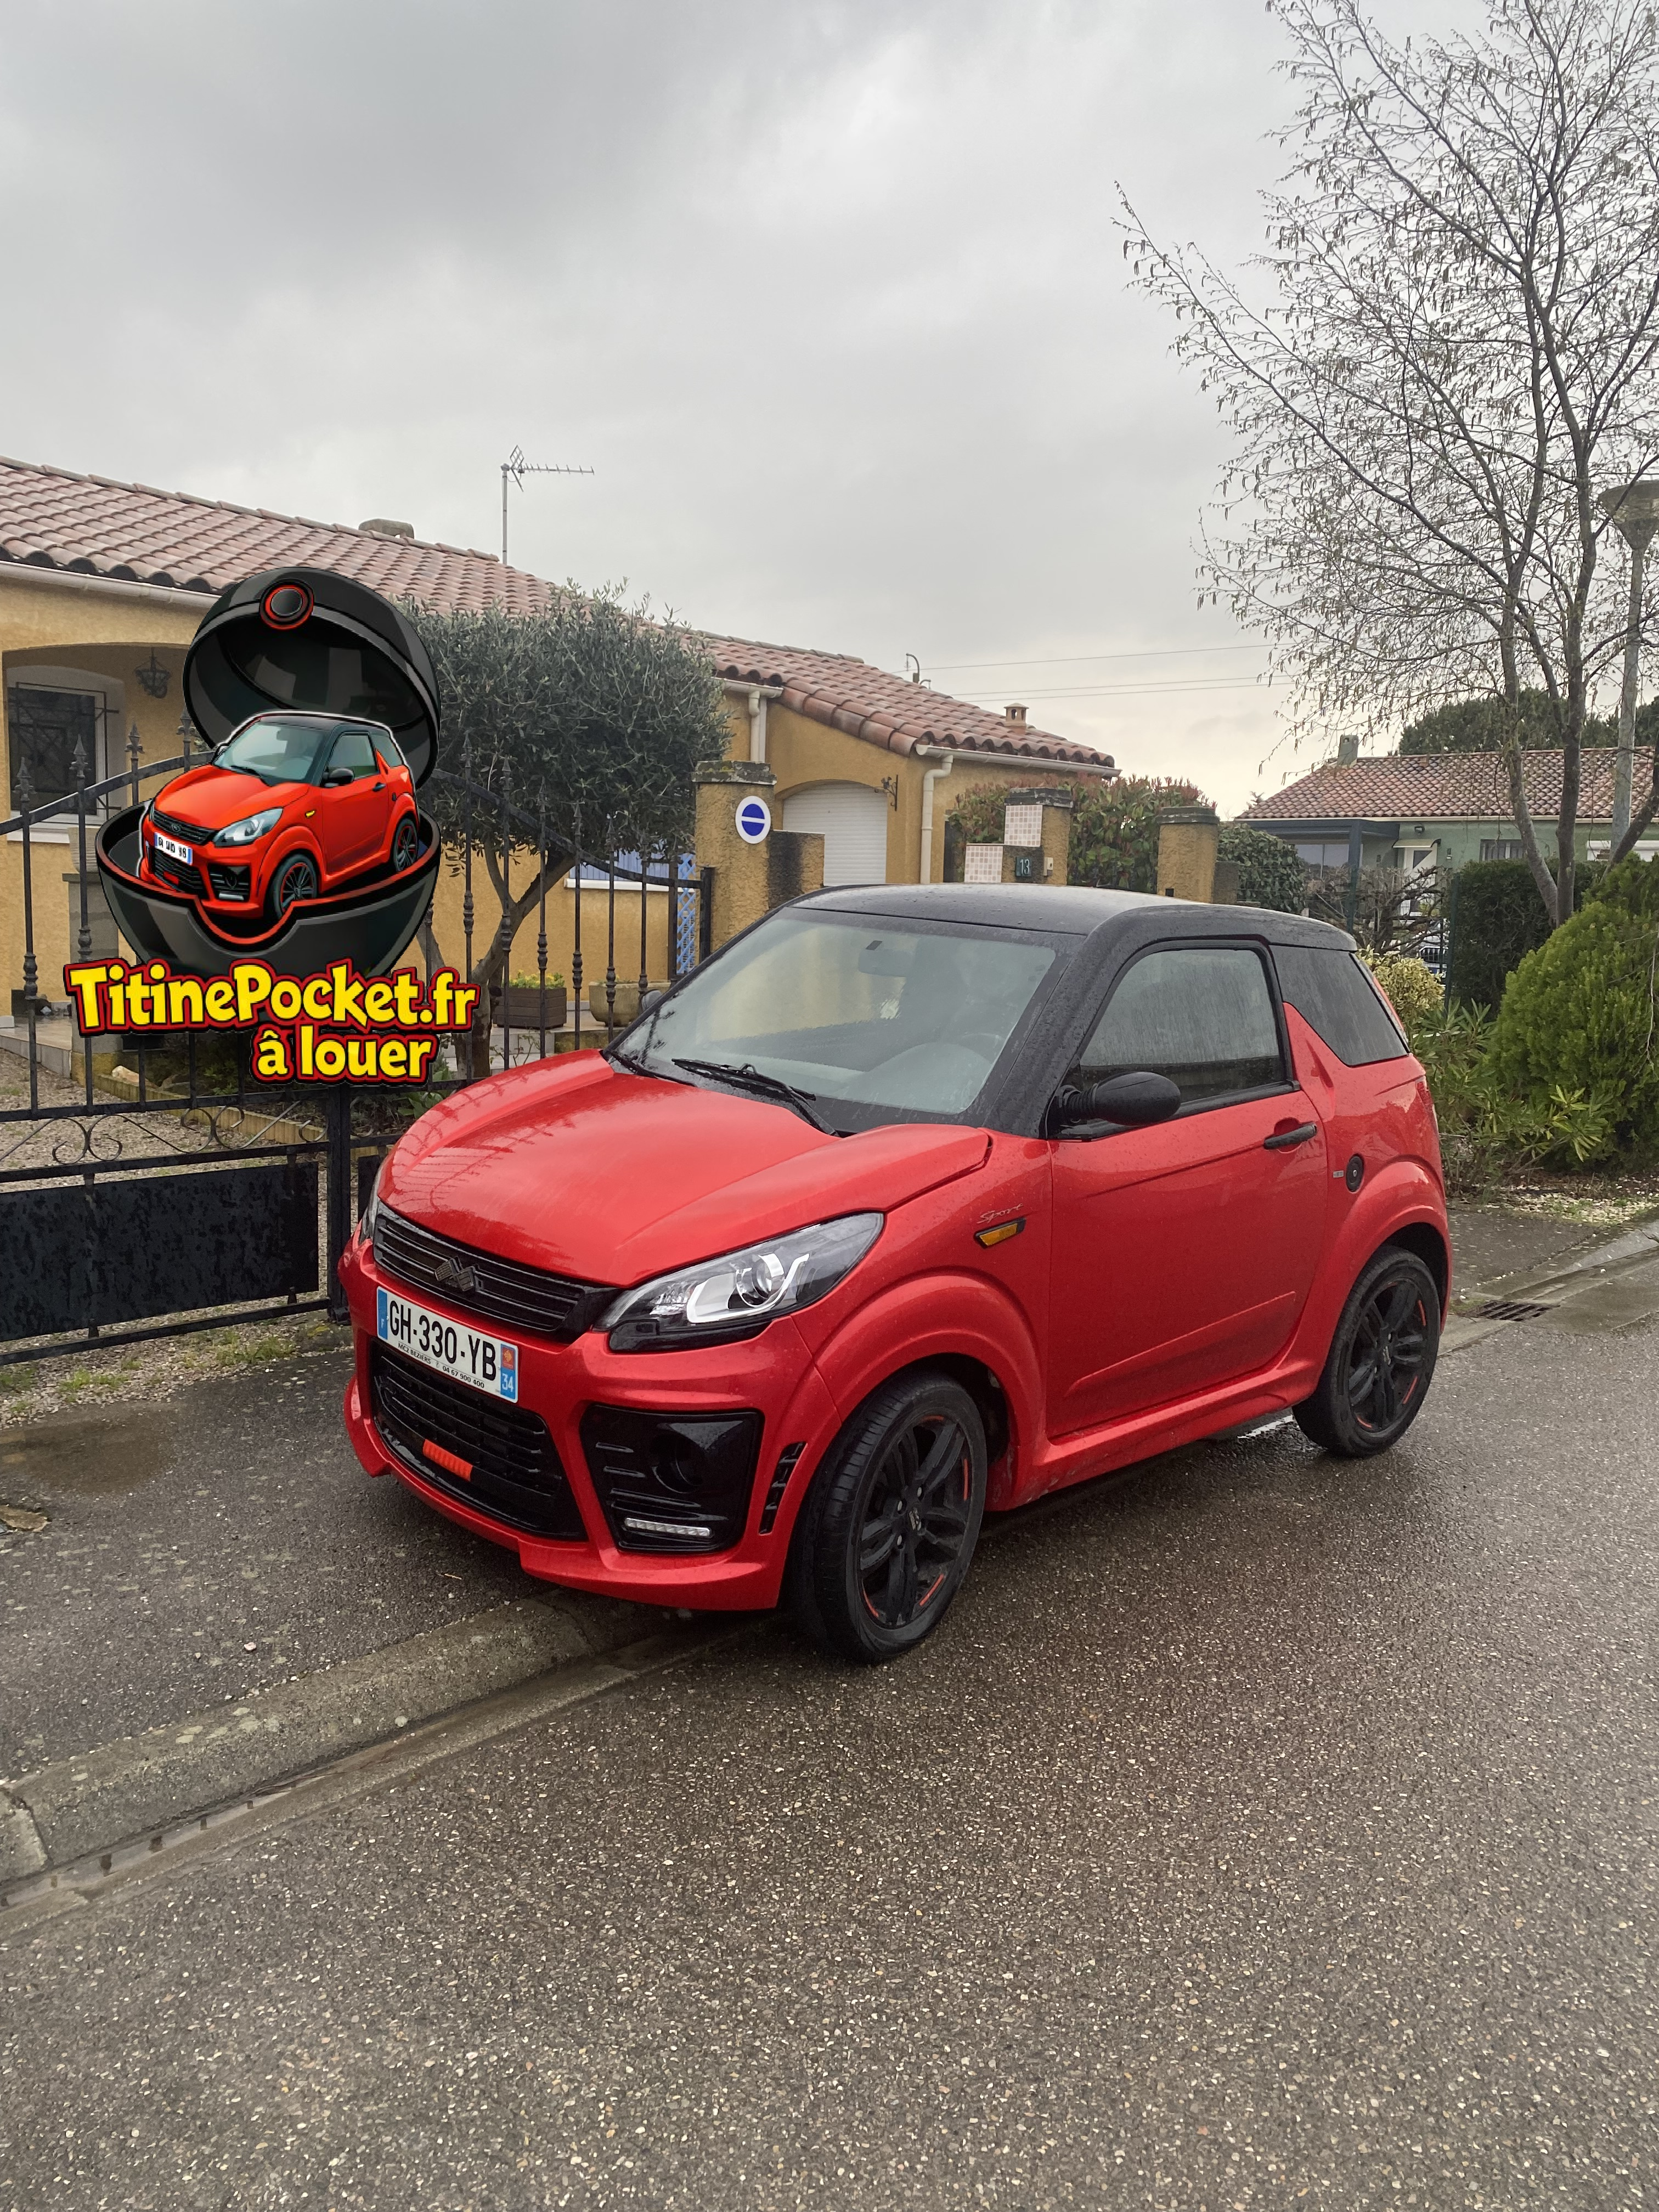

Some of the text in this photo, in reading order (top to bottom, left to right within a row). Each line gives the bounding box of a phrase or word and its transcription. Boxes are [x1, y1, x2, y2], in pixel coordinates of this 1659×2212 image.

[1020, 859, 1030, 874] 13
[380, 1318, 385, 1328] F
[390, 1300, 496, 1381] GH-330-YB
[398, 1342, 409, 1353] MC2
[410, 1349, 431, 1364] BEZIERS
[460, 1373, 471, 1383] 900
[472, 1379, 484, 1389] 400
[501, 1373, 514, 1392] 34
